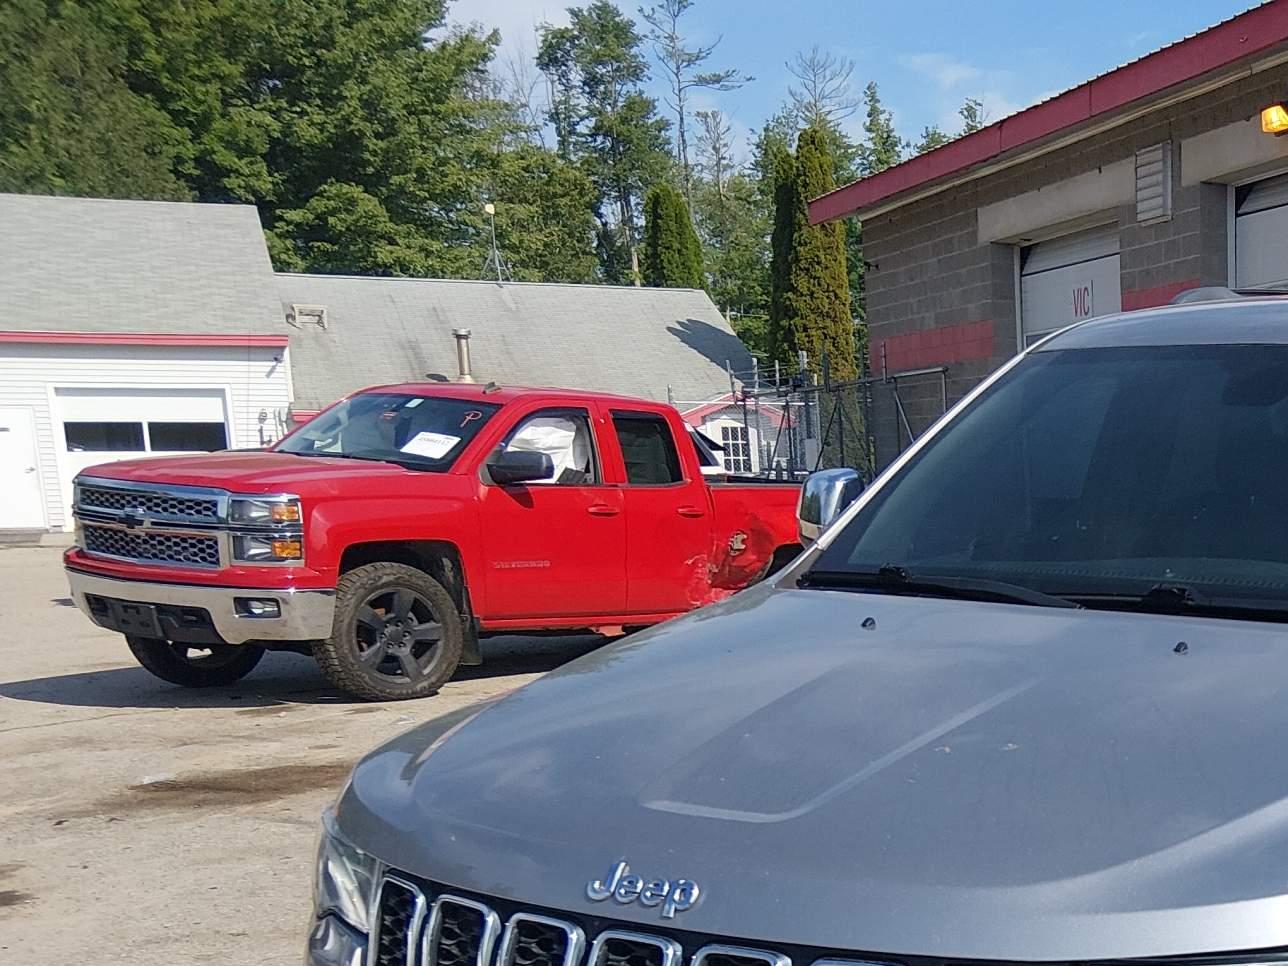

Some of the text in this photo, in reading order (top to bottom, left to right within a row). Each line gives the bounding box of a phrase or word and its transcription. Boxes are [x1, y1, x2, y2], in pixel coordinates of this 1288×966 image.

[1072, 286, 1090, 317] VIC
[460, 410, 483, 429] P
[586, 861, 701, 919] Jeep
